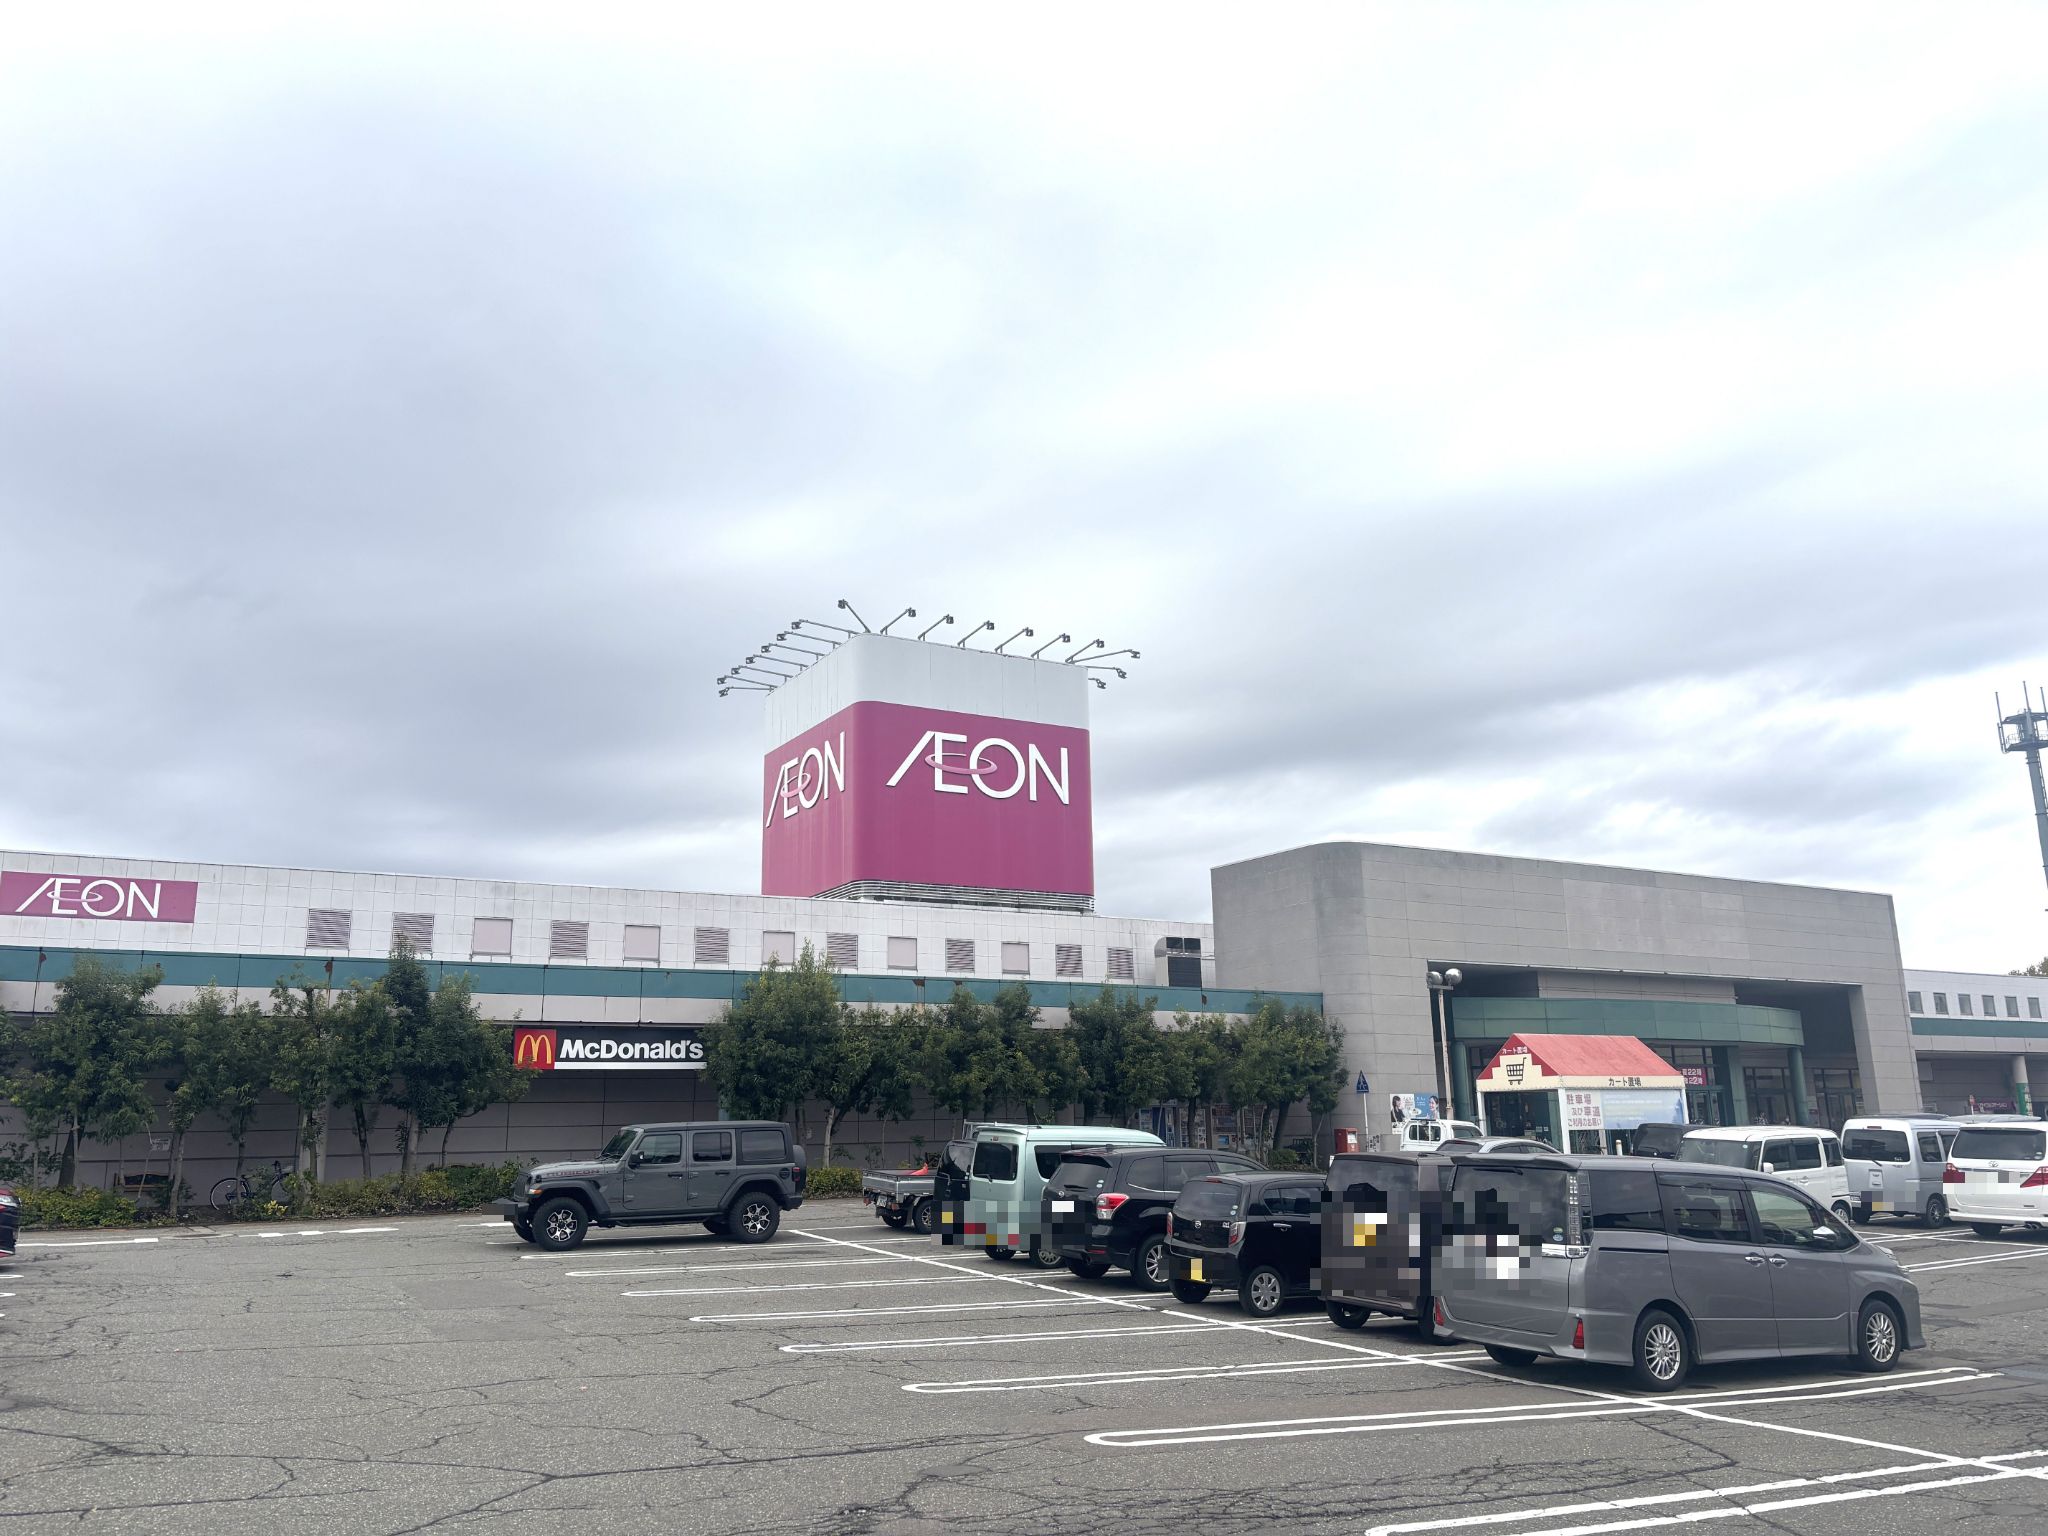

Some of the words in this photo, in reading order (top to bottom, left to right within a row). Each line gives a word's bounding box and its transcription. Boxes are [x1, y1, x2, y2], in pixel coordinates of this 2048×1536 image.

[560, 1039, 704, 1059] McDonald's
[1608, 1076, 1641, 1087] カート置場
[1566, 1094, 1592, 1105] 駐車場
